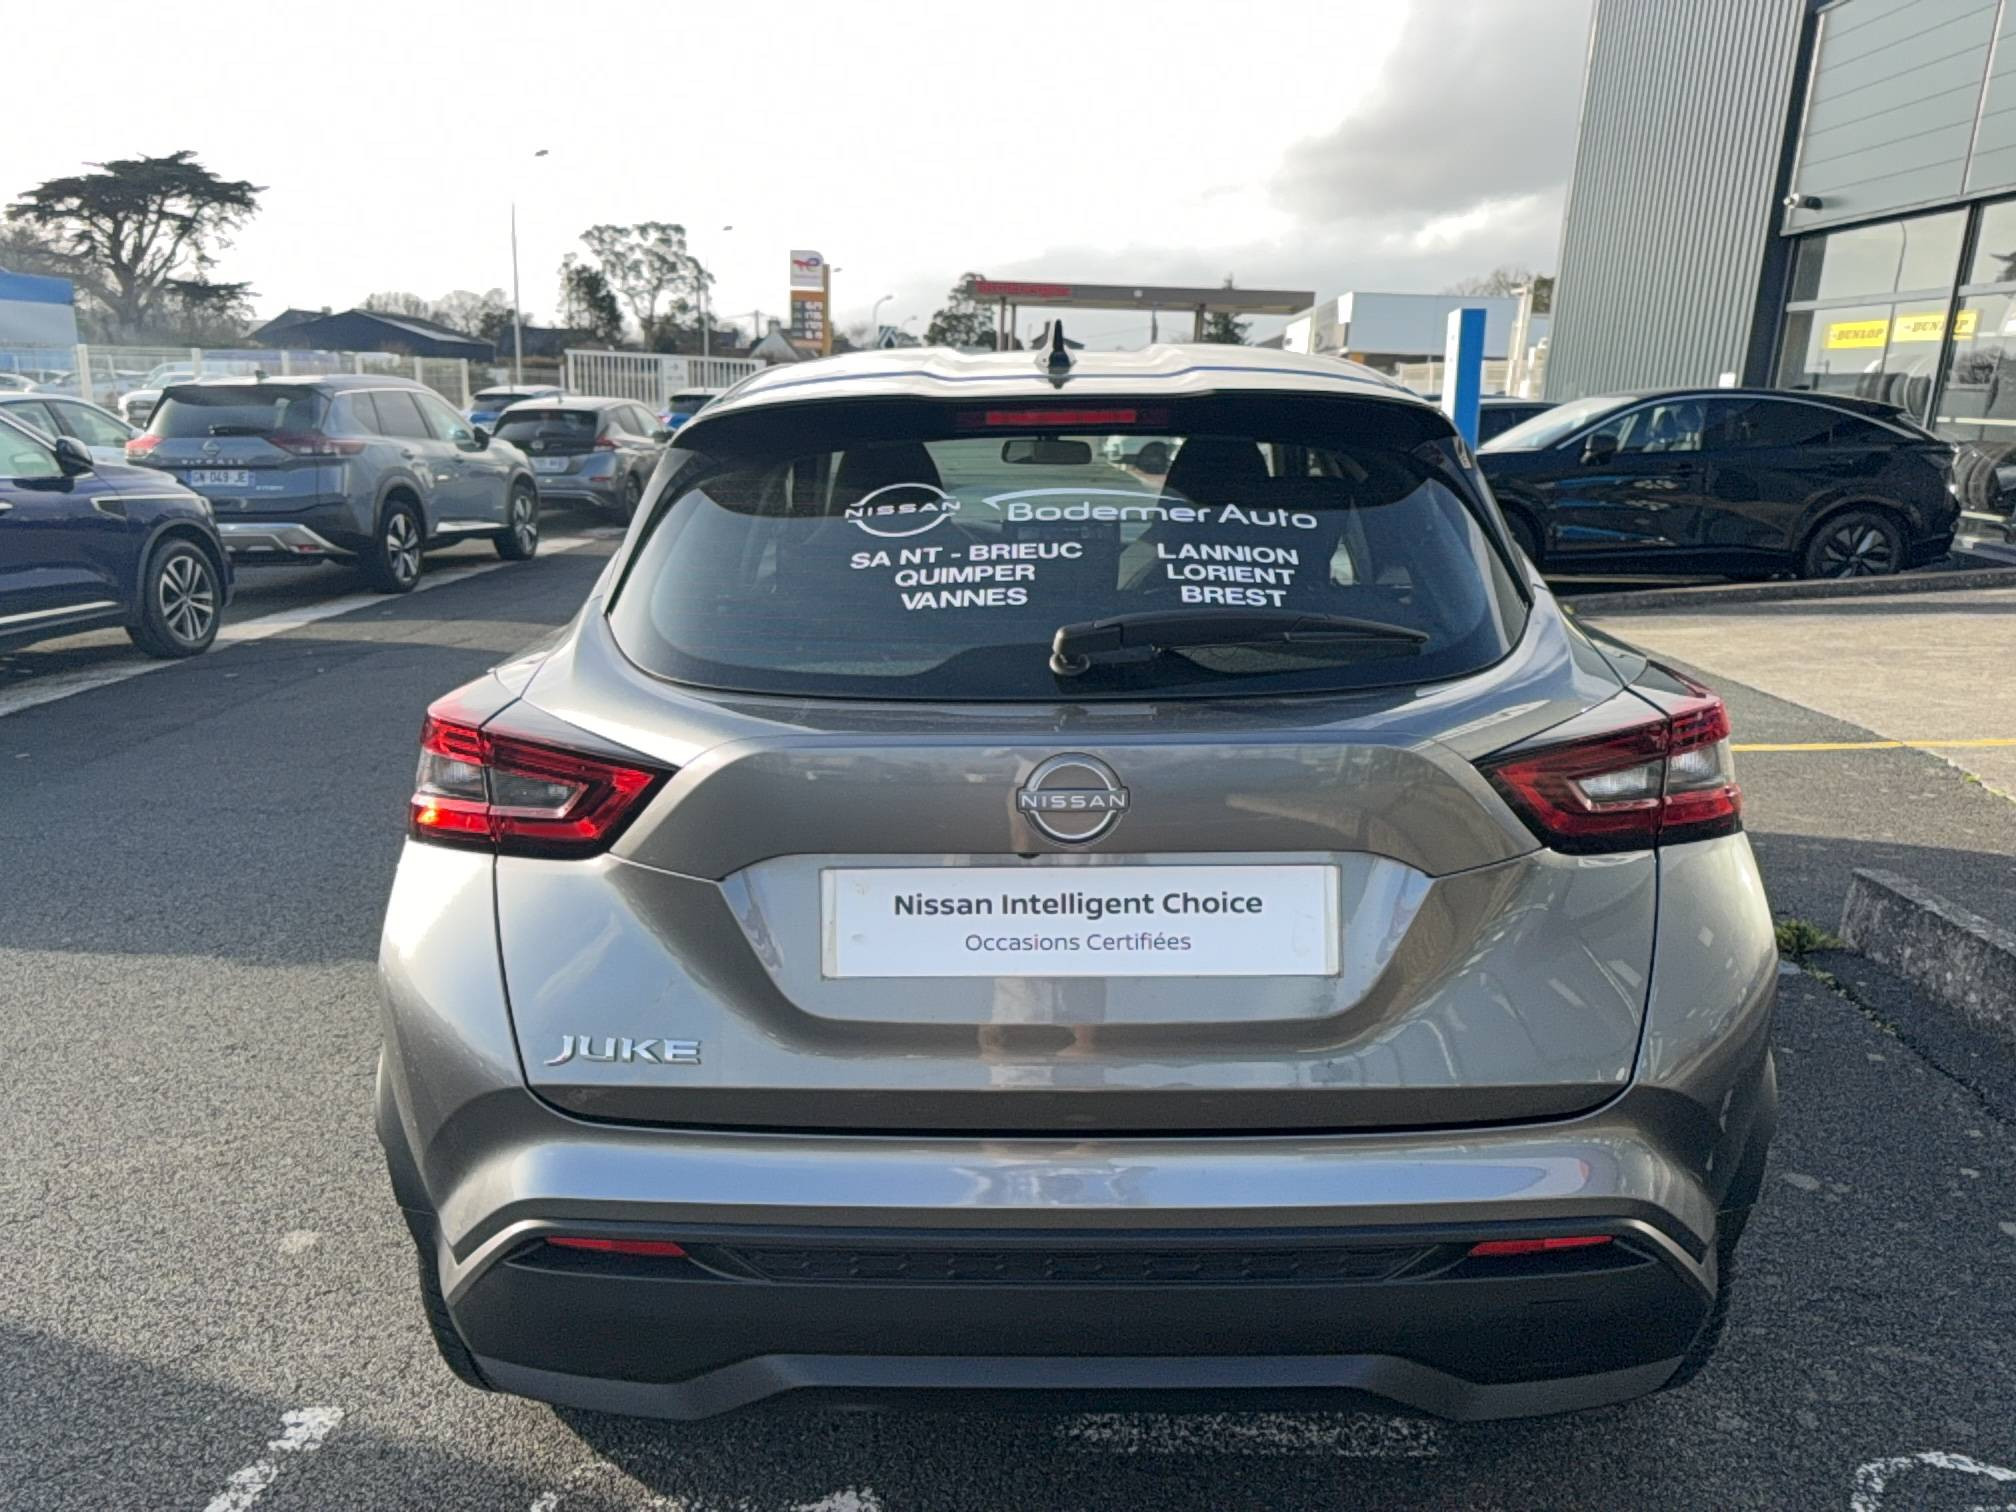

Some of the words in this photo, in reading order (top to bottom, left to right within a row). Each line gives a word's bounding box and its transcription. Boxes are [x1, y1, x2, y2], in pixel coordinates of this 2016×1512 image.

[1836, 328, 1885, 341] DUNLOP
[844, 500, 961, 519] NISSAN
[1007, 501, 1212, 523] Bodemer
[1218, 503, 1318, 529] Auto
[969, 542, 1084, 562] BRIEUC
[1156, 542, 1300, 566] LANNION
[894, 564, 1036, 587] QUIMPER
[1166, 563, 1295, 586] LORIENT
[901, 587, 1029, 611] VANNES
[1180, 585, 1287, 607] BREST
[1021, 793, 1126, 809] NISSAN
[893, 893, 993, 915] Nissan
[1001, 892, 1155, 920] Intelligent
[1162, 891, 1264, 915] Choice
[964, 933, 1081, 952] Occasions
[1086, 931, 1192, 952] Certifiées
[543, 1034, 703, 1067] JUKE
